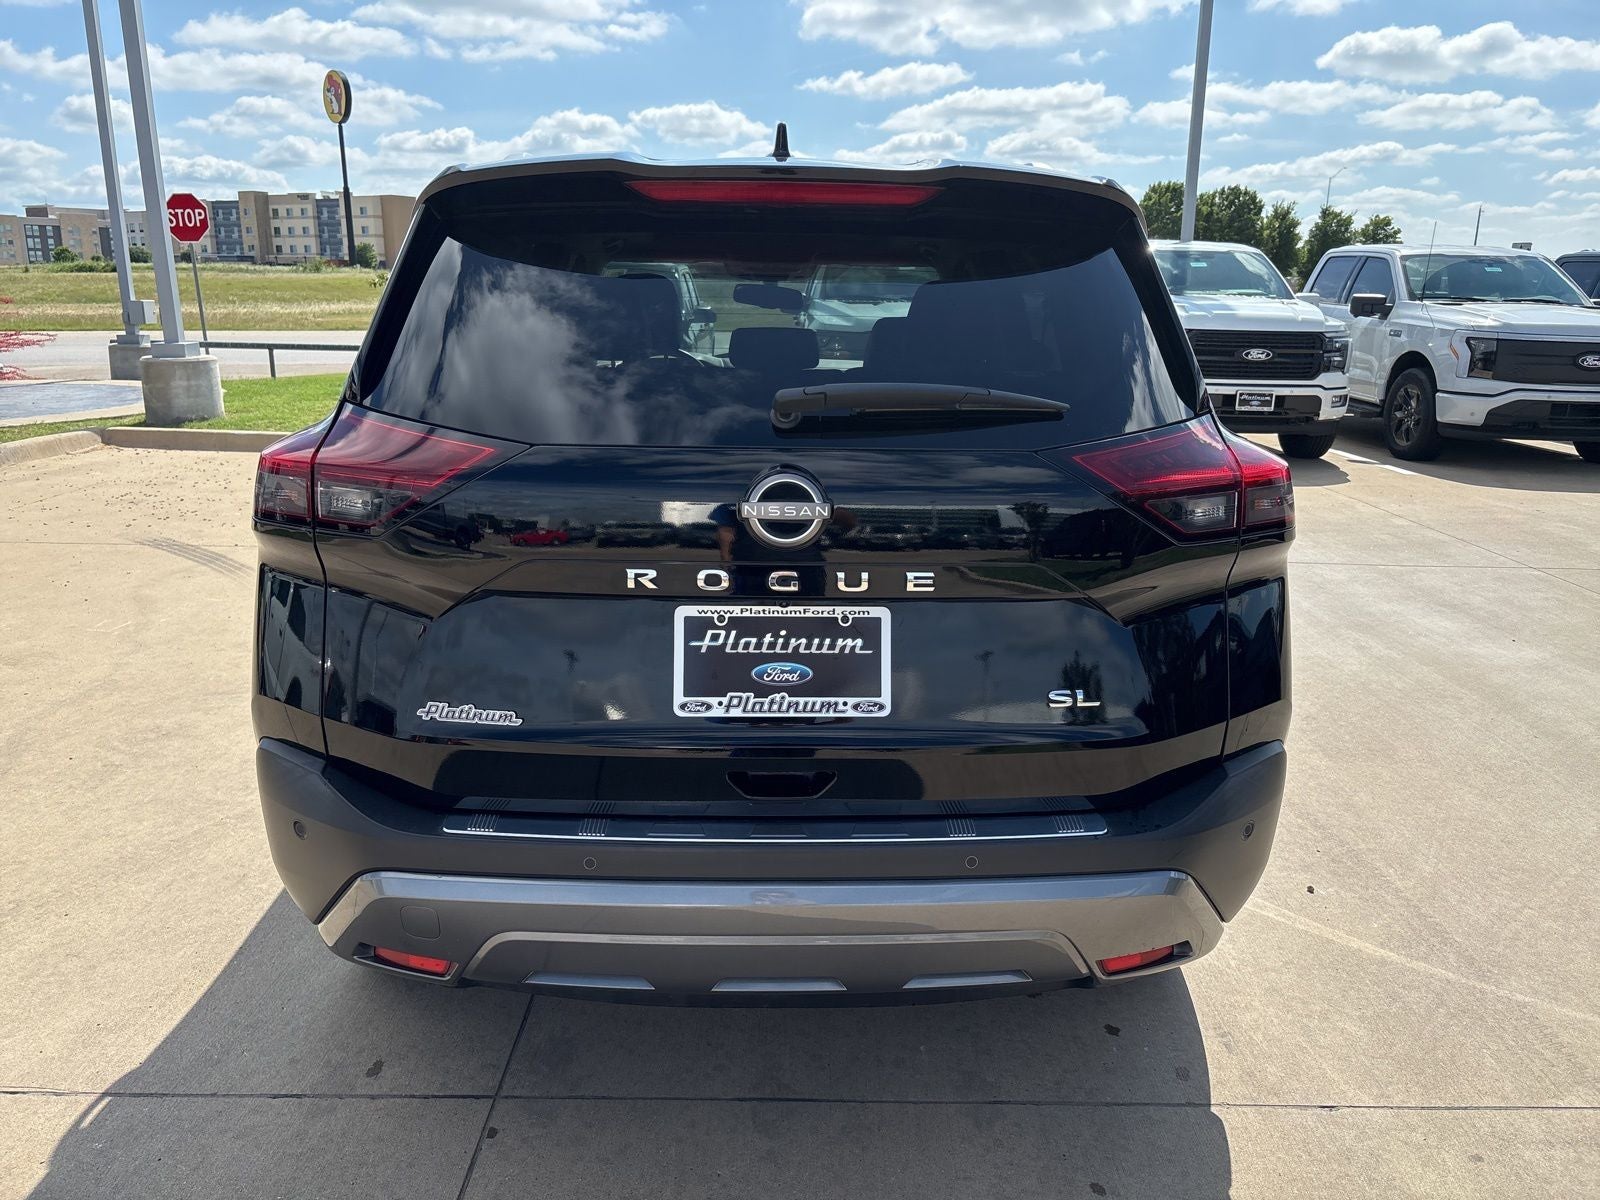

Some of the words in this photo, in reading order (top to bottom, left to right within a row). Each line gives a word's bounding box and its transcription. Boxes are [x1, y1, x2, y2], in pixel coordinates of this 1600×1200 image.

[167, 208, 205, 227] STOP
[1247, 350, 1268, 359] Ford
[743, 503, 828, 517] NISSAN
[625, 568, 936, 592] ROGUE
[696, 607, 871, 616] www.PlatinumFord.com
[688, 629, 874, 654] Platinum
[763, 665, 801, 683] Ford
[684, 702, 707, 712] Ford
[716, 693, 849, 715] Platinum
[857, 702, 880, 712] Ford
[1048, 689, 1101, 708] SL
[416, 701, 523, 726] Platinum
